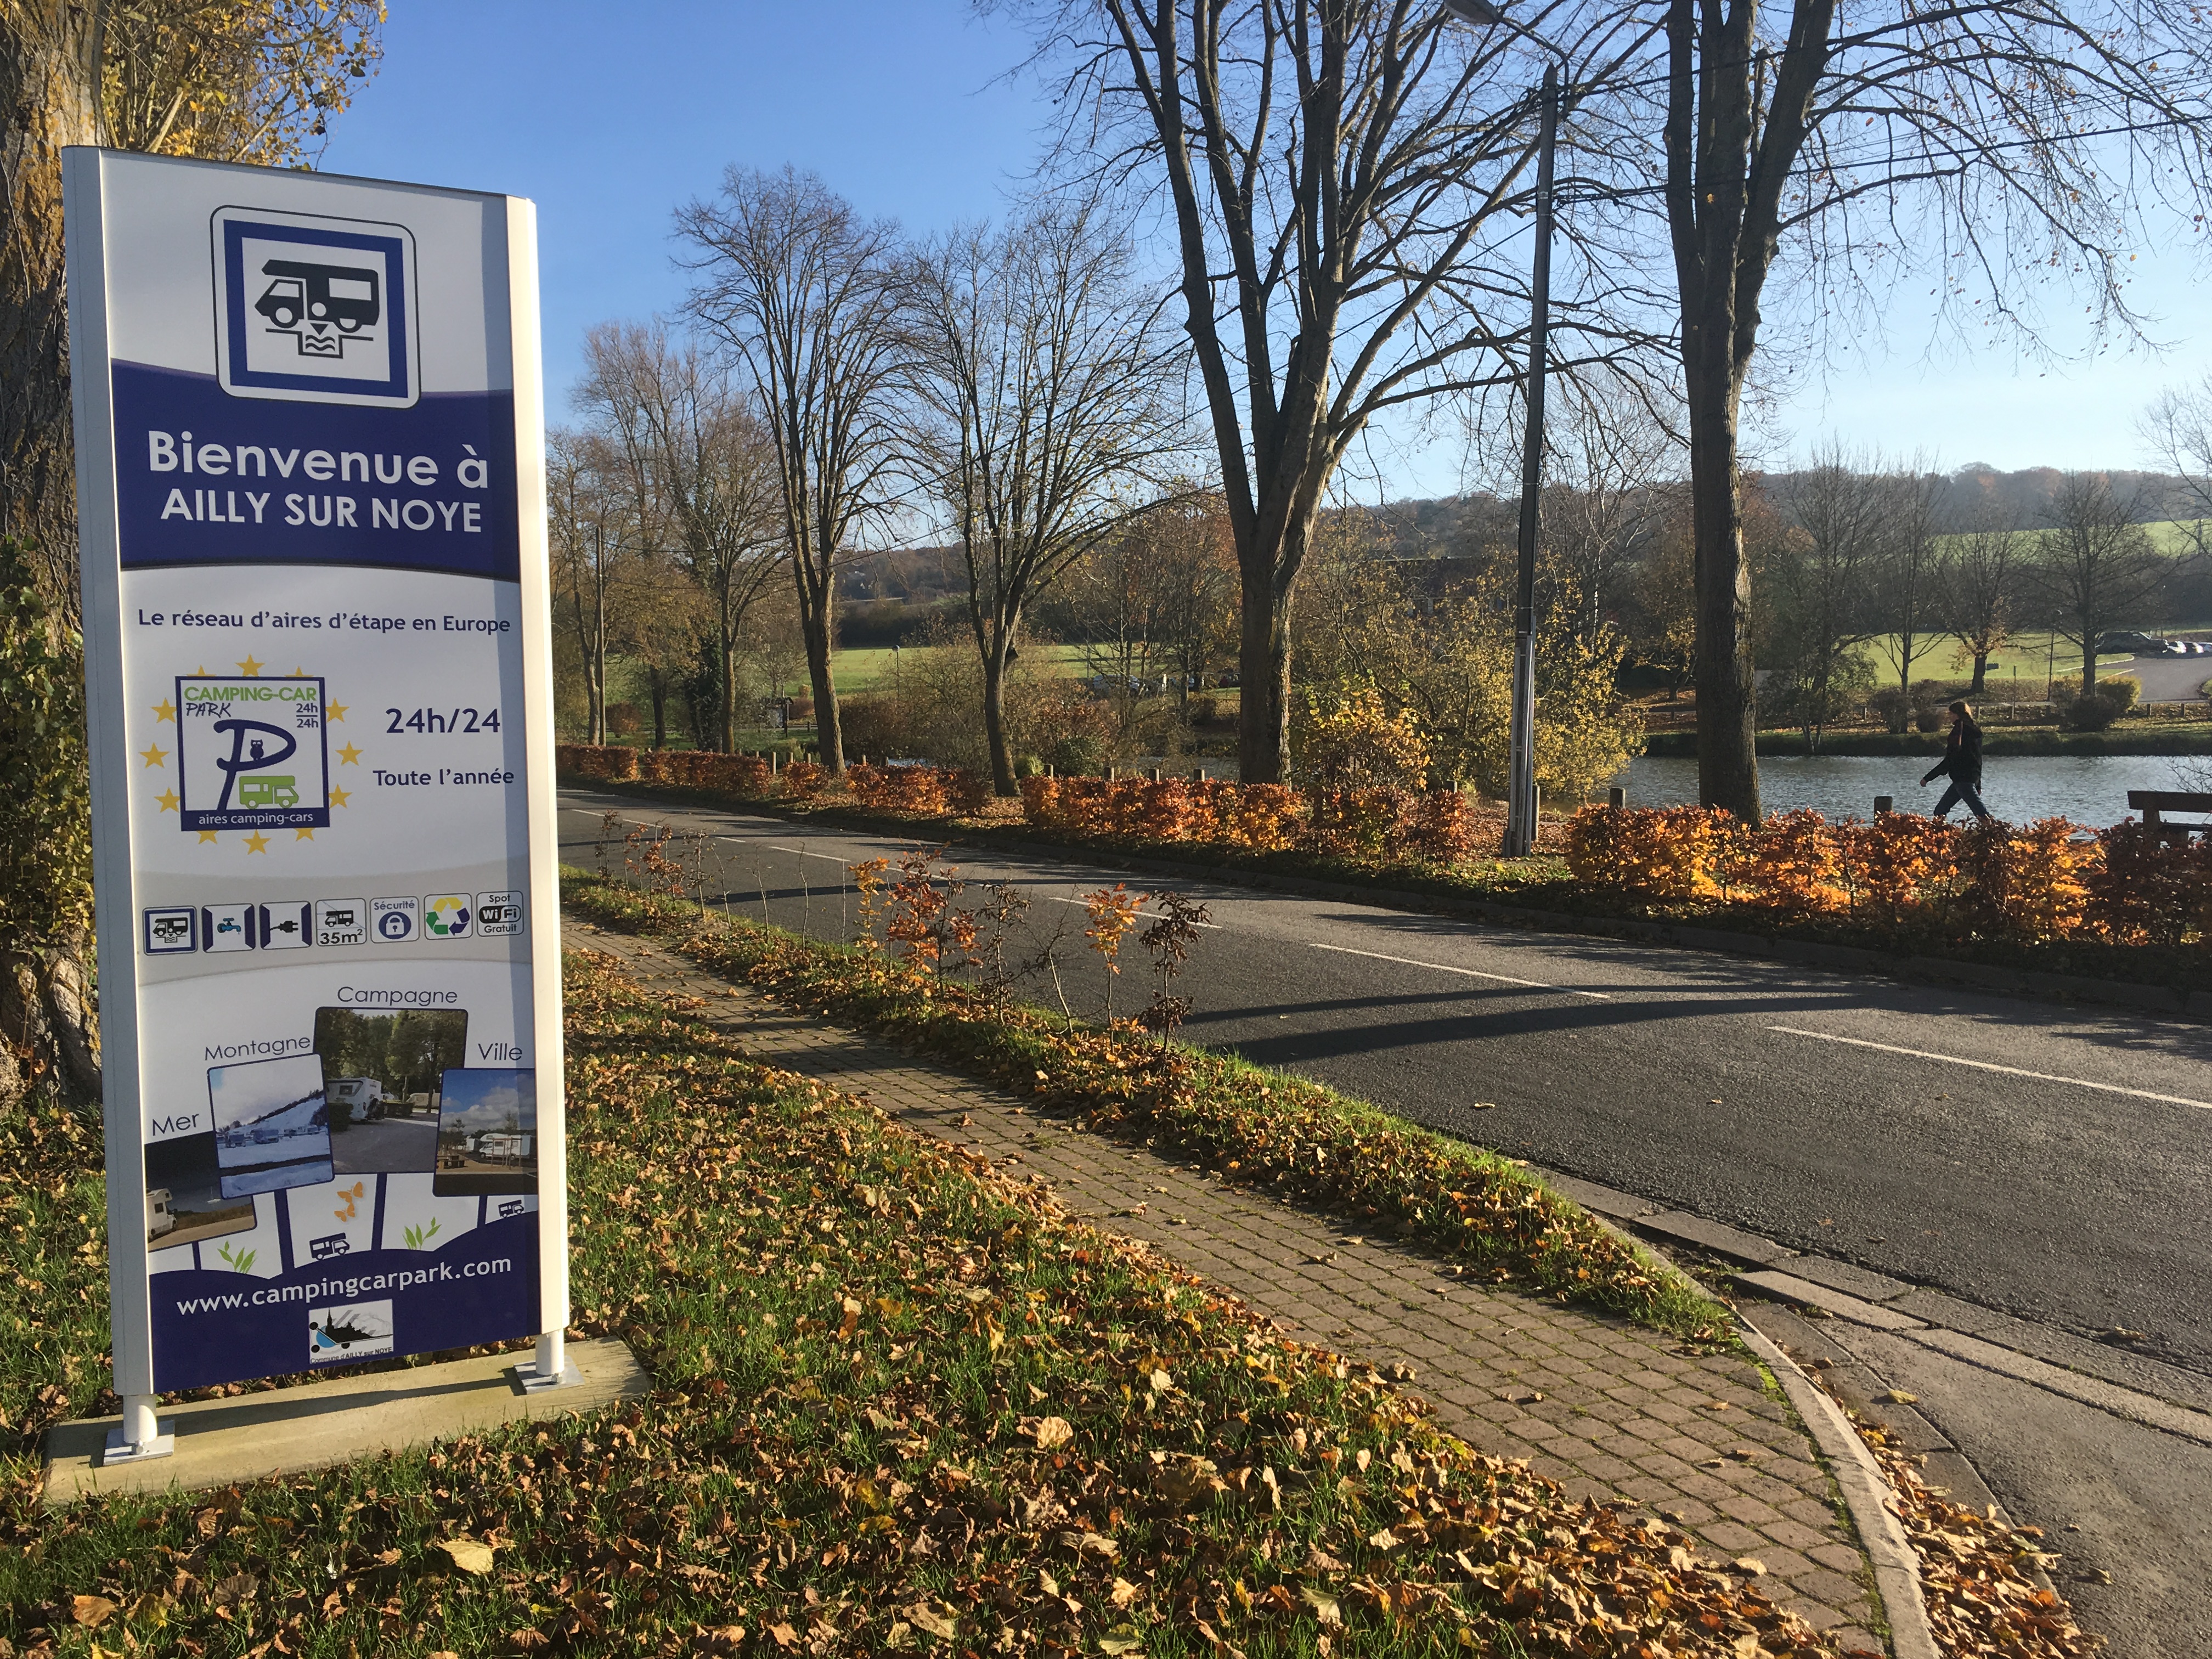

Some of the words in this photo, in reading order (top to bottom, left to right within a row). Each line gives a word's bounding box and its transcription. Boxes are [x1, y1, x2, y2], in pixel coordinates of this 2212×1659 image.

[148, 430, 439, 486] Bienvenue
[456, 444, 488, 489] à
[160, 488, 271, 524] AILLY
[284, 493, 358, 528] SUR
[372, 498, 482, 533] NOYE
[138, 609, 164, 627] Le
[172, 610, 243, 628] réseau
[413, 618, 436, 631] en
[443, 616, 511, 636] Europe
[184, 686, 317, 702] CAMPING-CAR
[185, 702, 232, 718] PARK
[296, 703, 318, 713] 24h
[296, 718, 319, 728] 24h
[386, 708, 501, 734] 24h/24
[373, 770, 432, 786] Toute
[199, 814, 228, 825] aires
[230, 812, 313, 825] camping-cars
[374, 900, 415, 911] Sécurité
[489, 894, 511, 904] Spot
[484, 923, 517, 934] Gratuit
[337, 986, 459, 1006] Campagne
[204, 1034, 311, 1062] Montagne
[478, 1042, 523, 1061] Ville
[152, 1113, 200, 1136] Mer
[176, 1257, 512, 1316] www.campingcarpark.com
